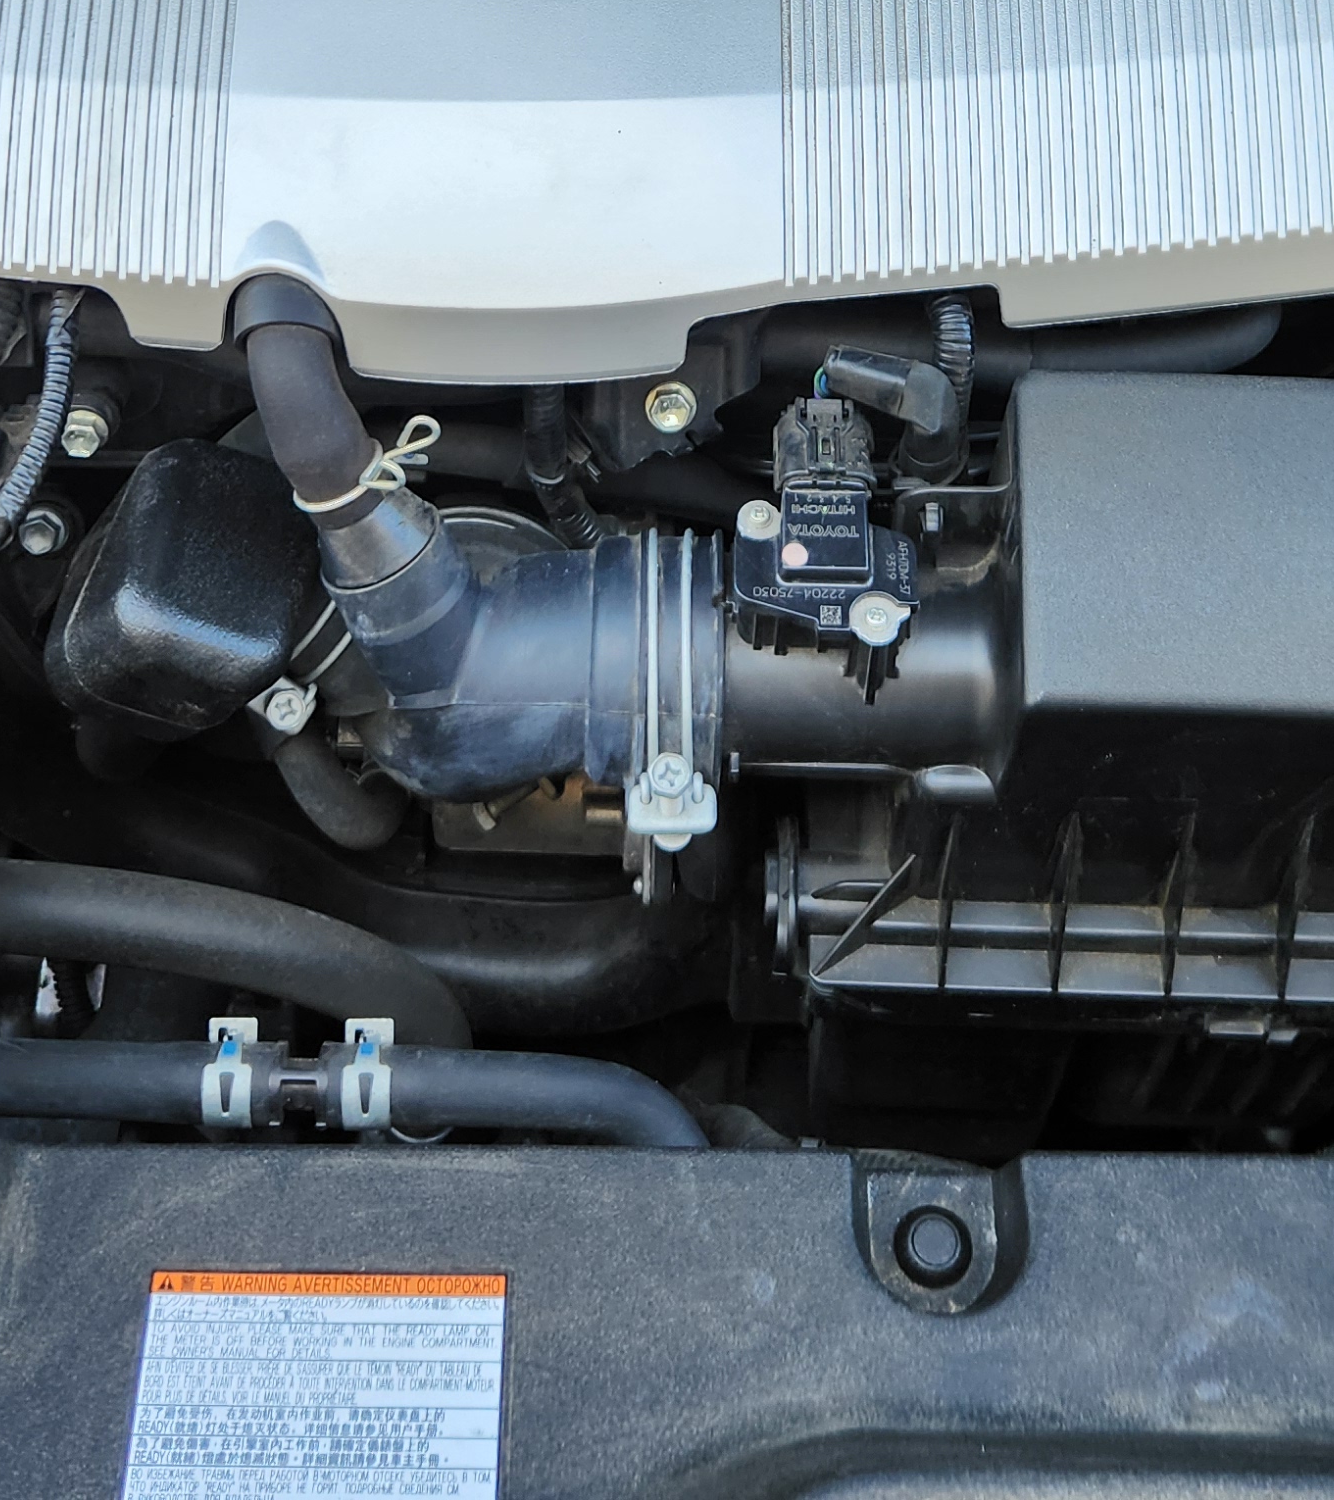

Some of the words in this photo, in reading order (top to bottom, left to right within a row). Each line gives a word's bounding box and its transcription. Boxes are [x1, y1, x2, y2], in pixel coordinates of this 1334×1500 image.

[791, 504, 856, 515] HITACHI
[787, 523, 860, 538] TOYOTA
[752, 586, 846, 599] 22204-75030
[220, 1276, 287, 1291] WARNING
[292, 1276, 411, 1292] AVERTISSEMENT
[416, 1278, 500, 1294] ОСТОРОЖНО
[152, 1323, 165, 1333] TO
[170, 1323, 200, 1333] AVOID
[247, 1324, 280, 1334] PLEASE
[288, 1324, 312, 1334] MAKE
[320, 1324, 345, 1335] SURE
[352, 1324, 375, 1335] THAT
[383, 1325, 399, 1335] THE
[405, 1325, 438, 1336] READY
[443, 1325, 469, 1336] LAMP
[475, 1325, 489, 1336] ON
[150, 1334, 168, 1344] THE
[173, 1334, 206, 1345] METER
[211, 1335, 220, 1345] IS
[226, 1335, 244, 1345] OFF
[249, 1335, 287, 1346] BEFORE
[293, 1336, 337, 1346] WORKING
[343, 1336, 352, 1346] IN
[359, 1336, 375, 1347] THE
[381, 1337, 415, 1347] ENGINE
[147, 1345, 166, 1356] SEE
[219, 1346, 260, 1357] MANUAL
[265, 1346, 286, 1358] FOR
[145, 1360, 162, 1373] AFIN
[196, 1361, 206, 1374] DE
[209, 1361, 218, 1374] SE
[283, 1361, 292, 1374] DE
[336, 1362, 349, 1375] QUE
[353, 1362, 362, 1375] LE
[425, 1363, 435, 1376] DU
[440, 1363, 469, 1376] TABLEAU
[473, 1363, 481, 1377] DE
[143, 1375, 164, 1388] BORD
[166, 1375, 180, 1388] EST
[209, 1375, 233, 1388] AVANT
[236, 1375, 245, 1389] DE
[298, 1376, 319, 1389] TOUTE
[323, 1376, 372, 1390] INTERVENTION
[375, 1377, 394, 1390] DANS
[397, 1377, 405, 1390] LE
[141, 1389, 161, 1402] POUR
[164, 1389, 183, 1402] PLUS
[185, 1390, 194, 1402] DE
[230, 1390, 248, 1403] VOIR
[250, 1390, 259, 1403] LE
[263, 1390, 291, 1403] MANUEL
[294, 1391, 305, 1404] DU
[130, 1467, 142, 1479] ВО
[145, 1468, 195, 1479] ИЗБЕЖАНИЕ
[238, 1469, 265, 1480] ПЕРЕД
[372, 1470, 404, 1482] ОТСЕКЕ
[128, 1480, 146, 1491] ЧТО
[149, 1480, 199, 1492] ИНДИКАТОР
[238, 1481, 250, 1492] НА
[254, 1481, 291, 1493] ПРИБОРЕ
[296, 1482, 306, 1493] НЕ
